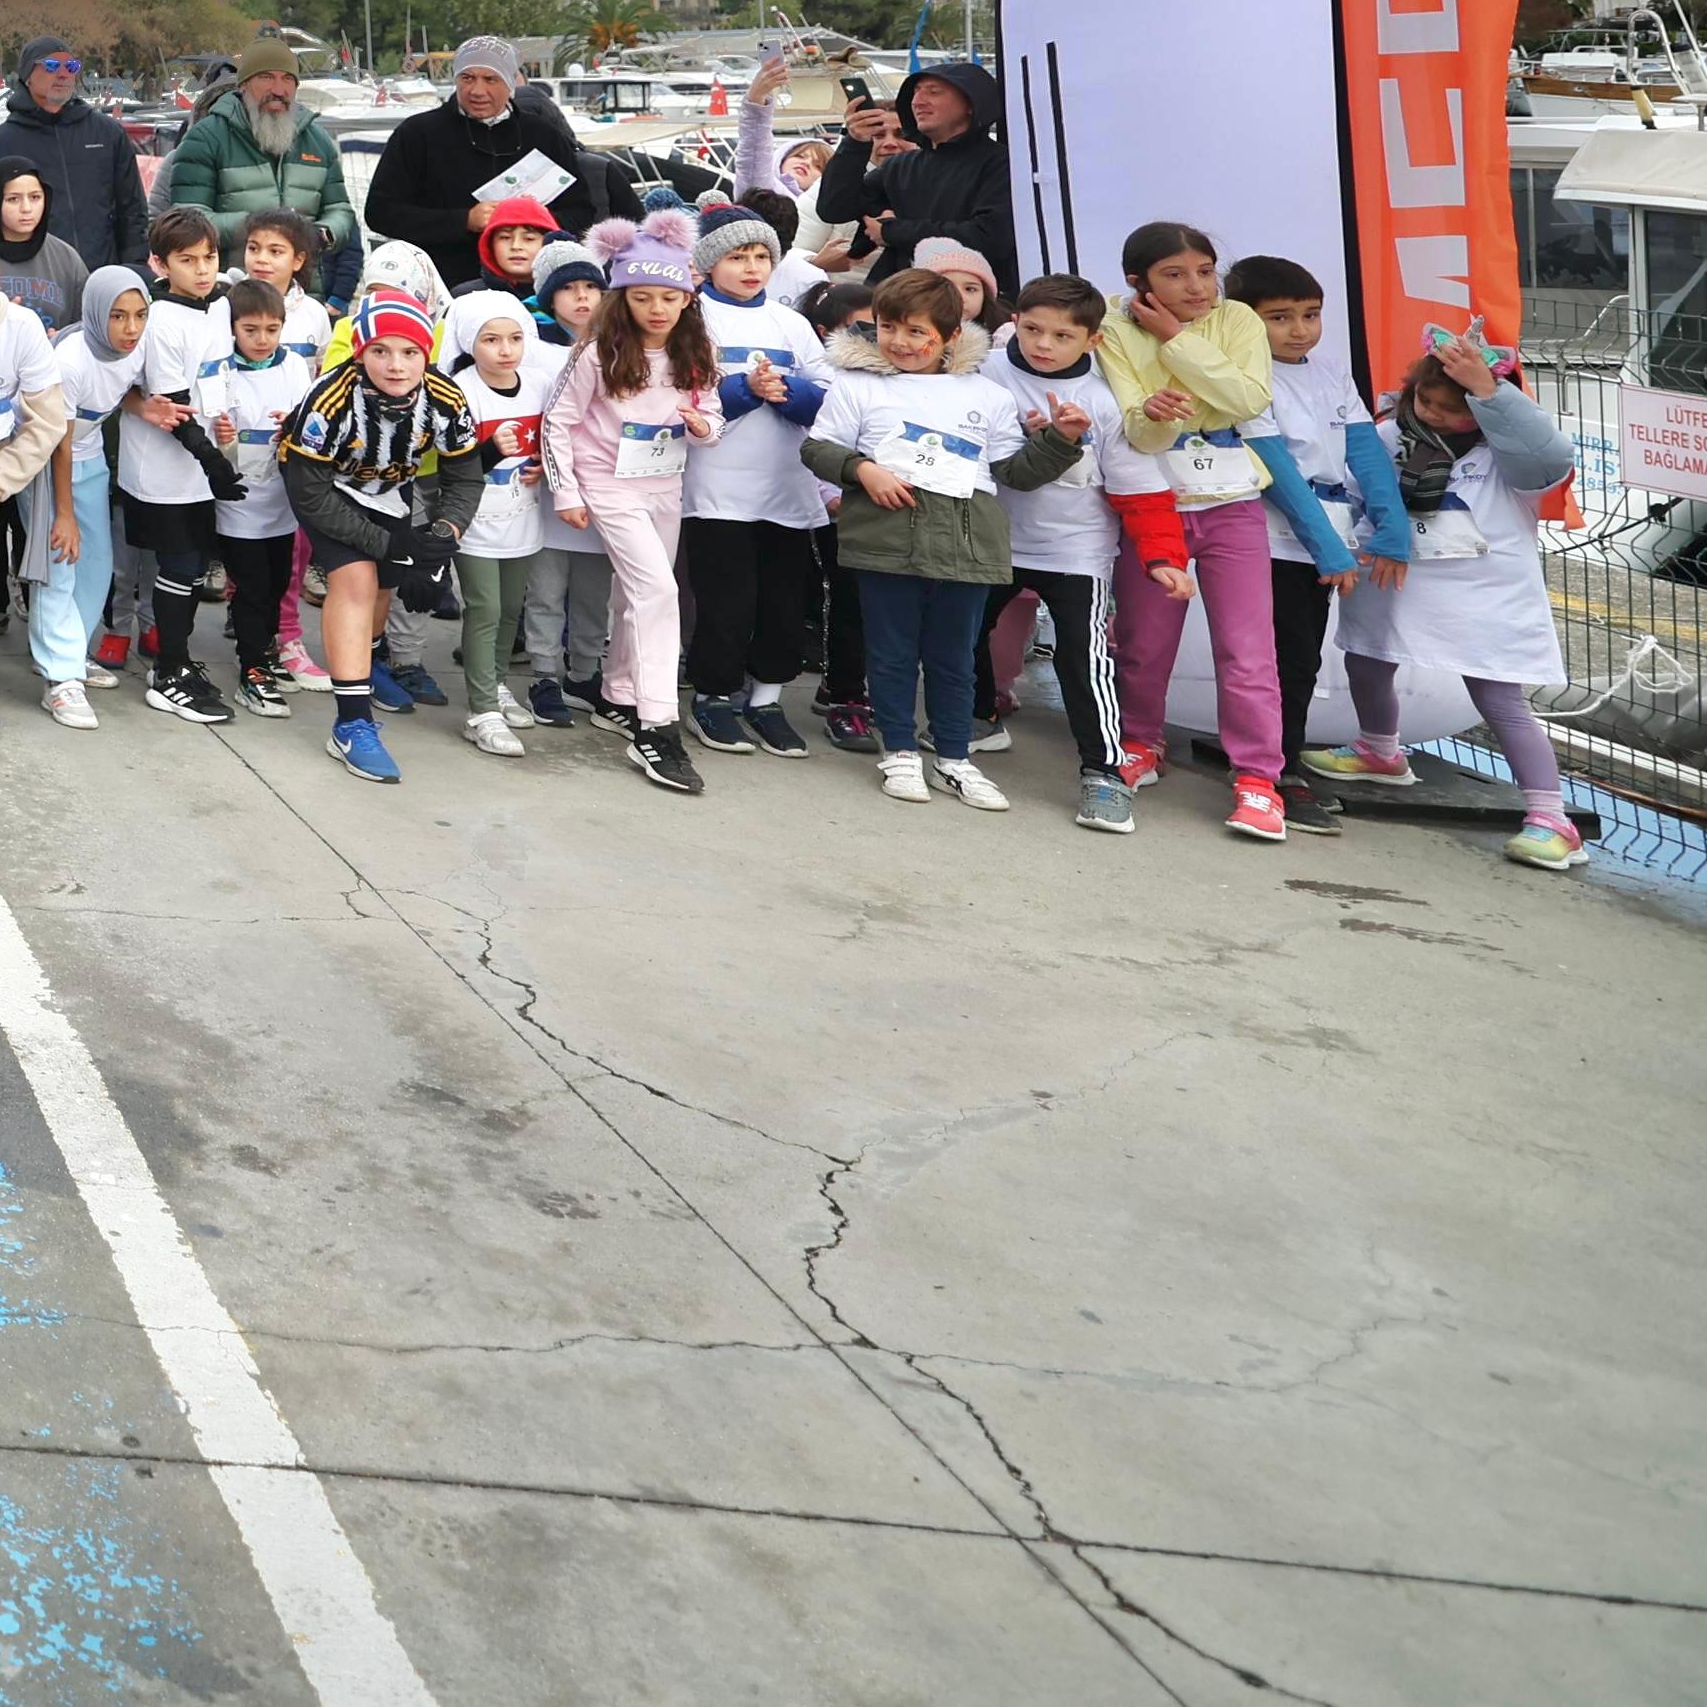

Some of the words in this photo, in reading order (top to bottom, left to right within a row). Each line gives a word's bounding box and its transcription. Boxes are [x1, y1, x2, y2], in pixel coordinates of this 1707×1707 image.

[1628, 423, 1690, 449] TELLERE
[650, 446, 665, 458] 73
[914, 453, 936, 467] 28
[1193, 458, 1214, 471] 67
[1416, 522, 1427, 535] 8
